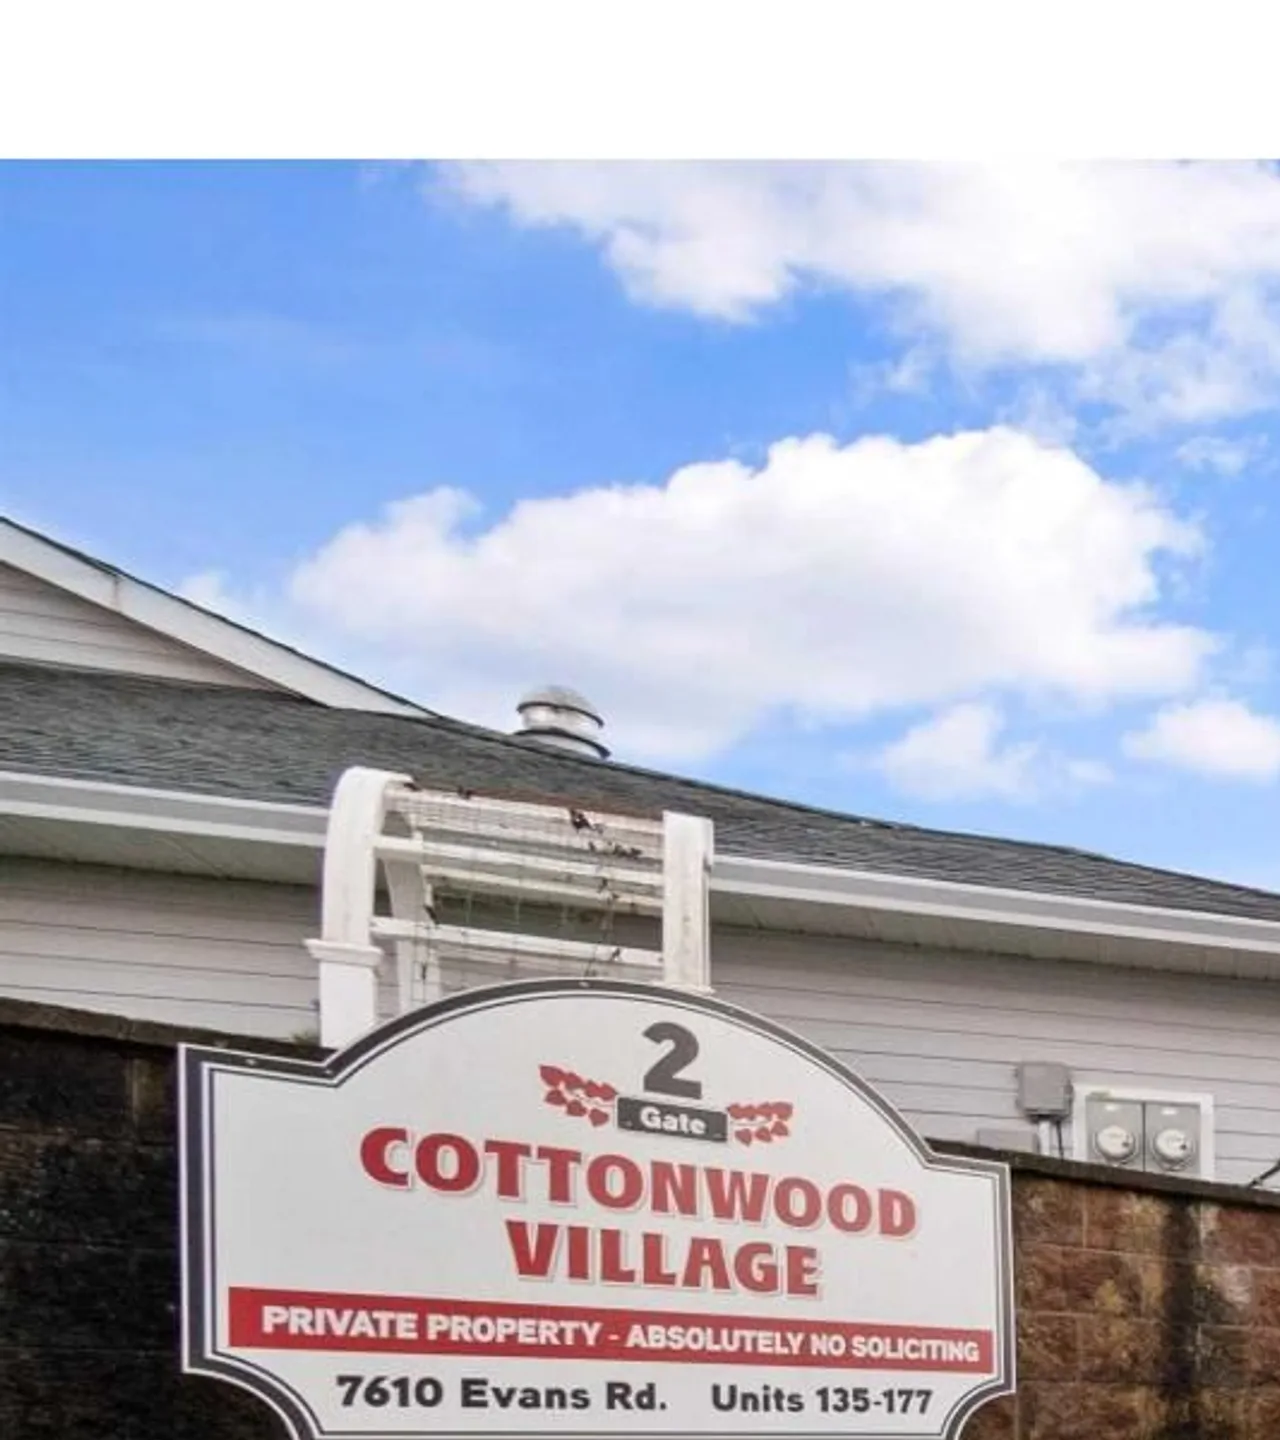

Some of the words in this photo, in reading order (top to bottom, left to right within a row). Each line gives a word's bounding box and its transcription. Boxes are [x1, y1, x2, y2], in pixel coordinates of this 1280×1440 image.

[642, 1021, 702, 1099] 2
[639, 1106, 707, 1136] Gate
[359, 1126, 918, 1238] COTTONWOOD
[504, 1218, 822, 1296] VILLAGE
[262, 1304, 418, 1339] PRIVATE
[426, 1313, 603, 1346] PROPERTY
[625, 1324, 804, 1356] ABSOLUTELY
[810, 1335, 845, 1357] NO
[851, 1337, 981, 1363] SOLICITING
[337, 1374, 443, 1408] 7610
[461, 1378, 591, 1410] Evans
[606, 1383, 667, 1412] Rd.
[712, 1384, 805, 1413] Units
[816, 1387, 933, 1415] 135-177
